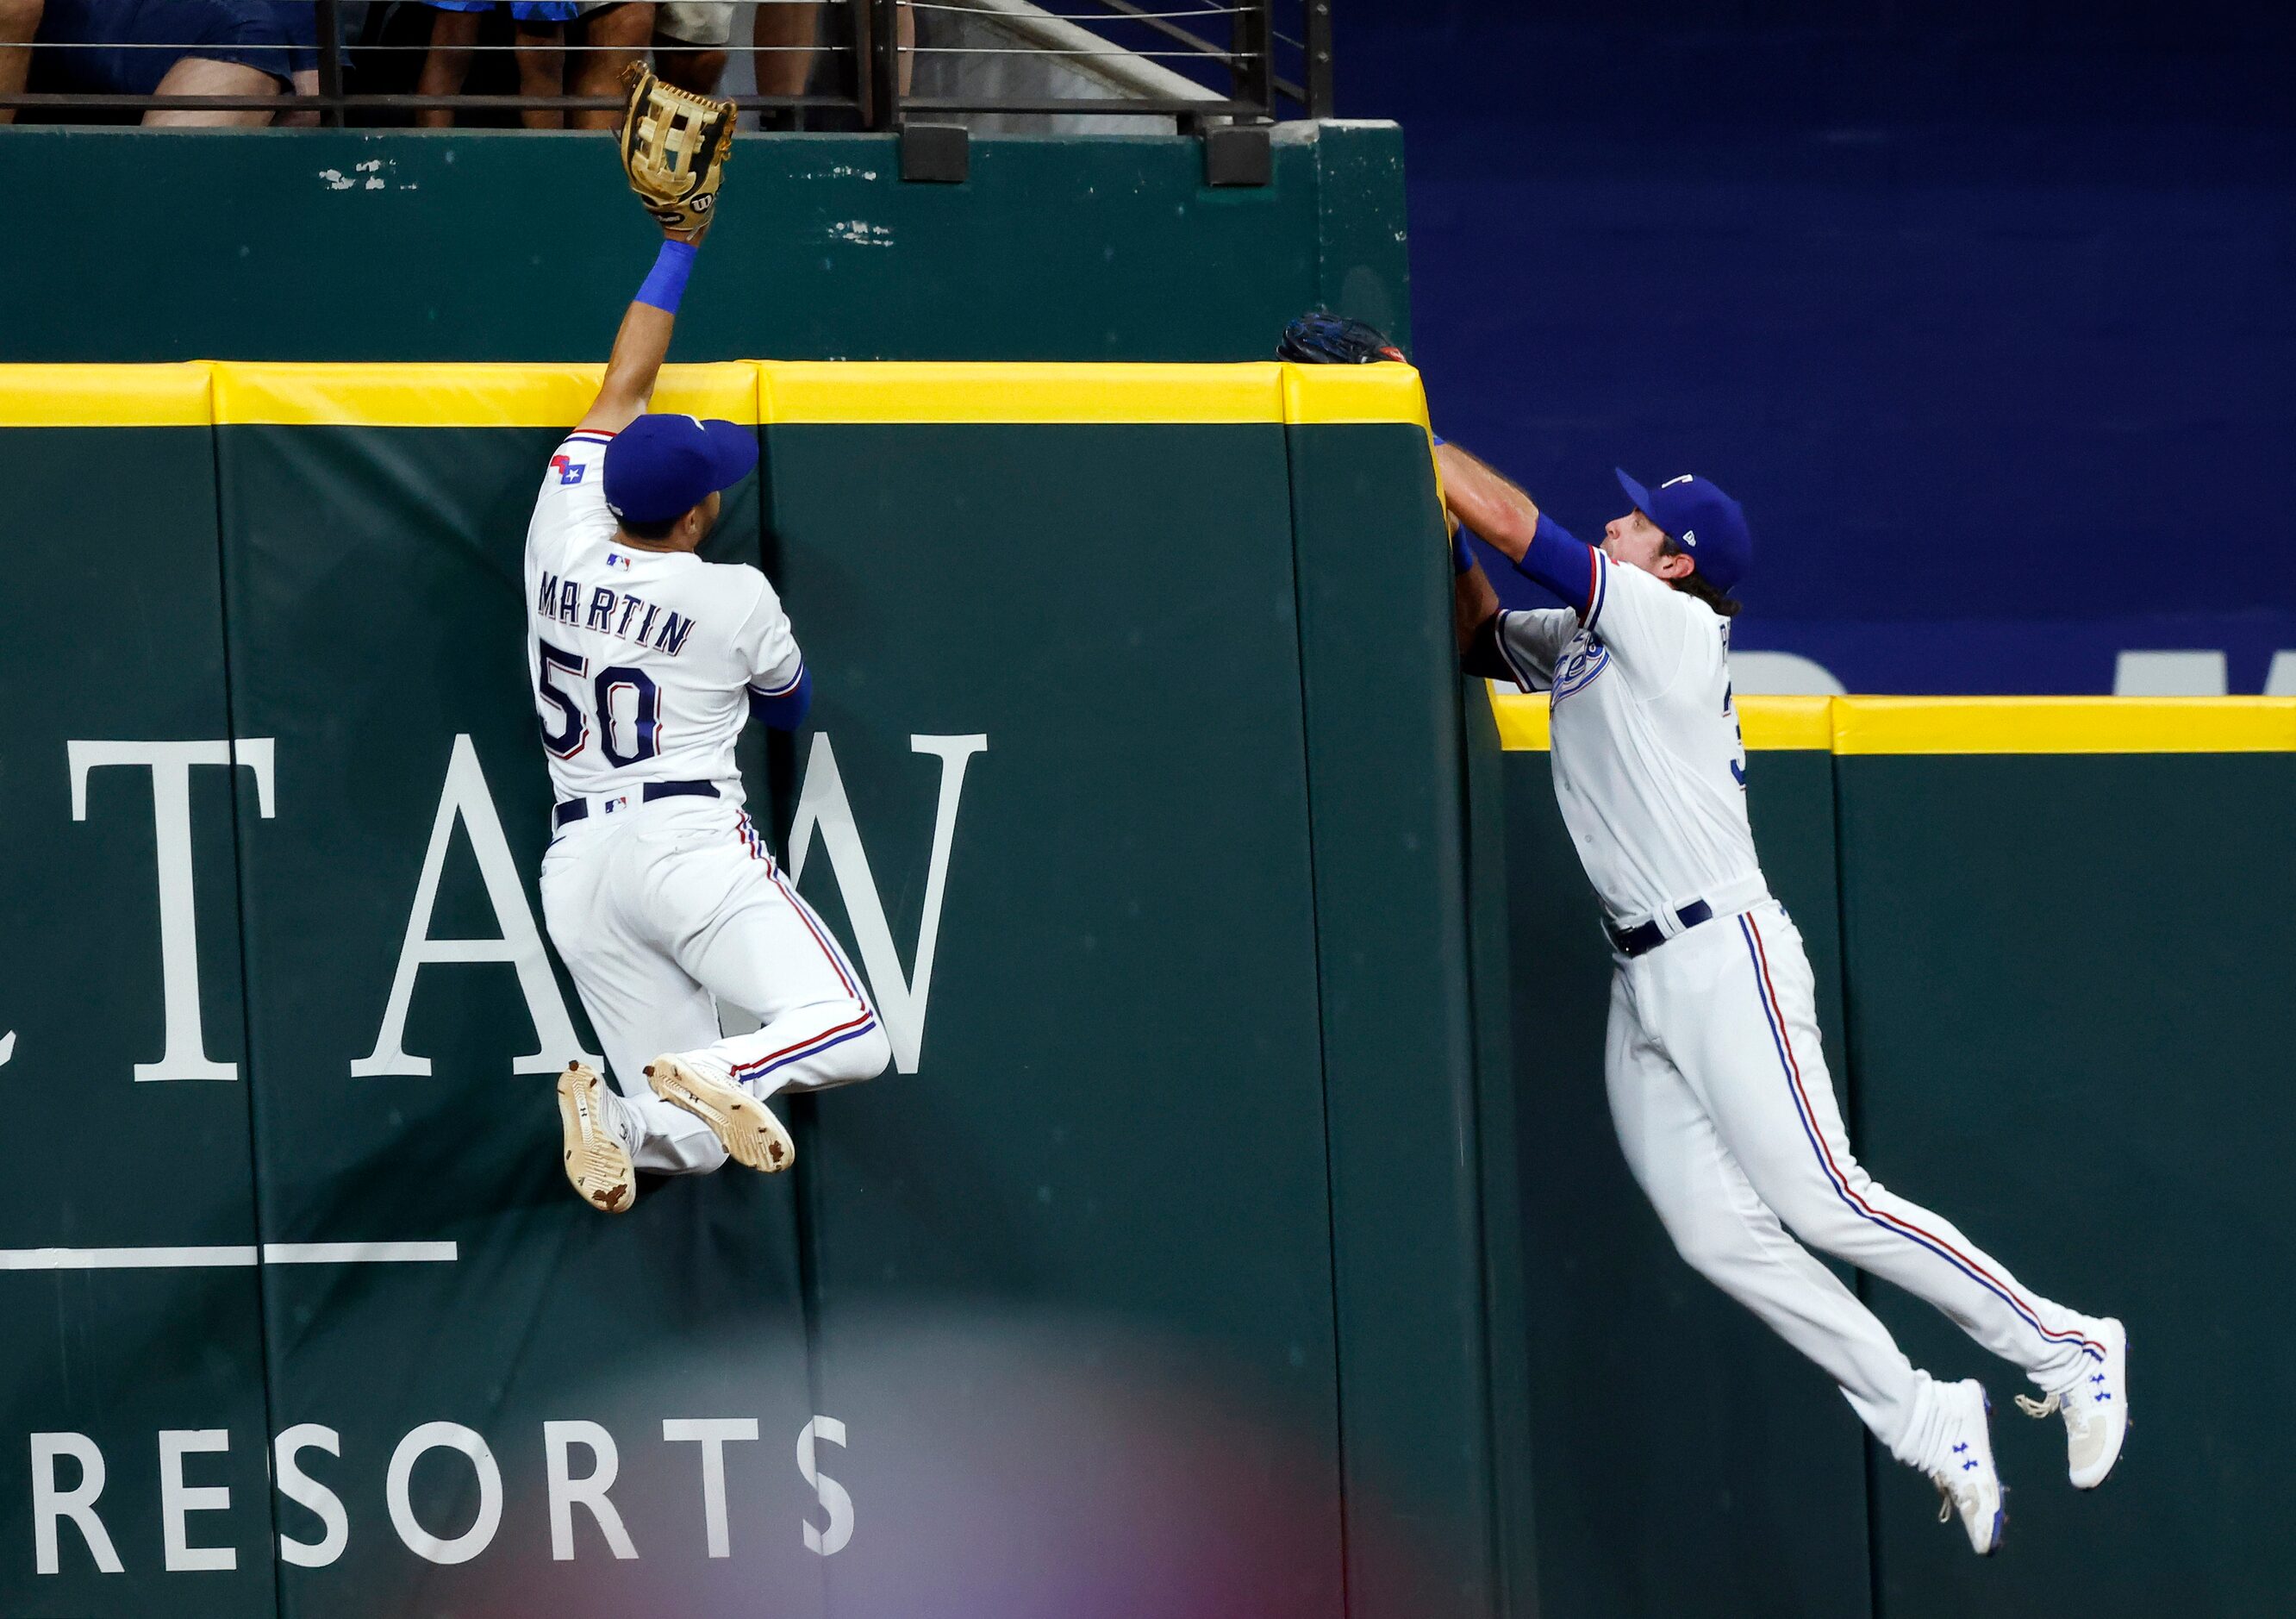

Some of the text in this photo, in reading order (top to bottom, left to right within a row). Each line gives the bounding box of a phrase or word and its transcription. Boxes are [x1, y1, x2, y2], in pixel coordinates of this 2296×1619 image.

[537, 570, 696, 657] MARTIN
[538, 637, 662, 770] 50
[0, 733, 988, 1083] TAW
[30, 1415, 855, 1575] RESORTS
